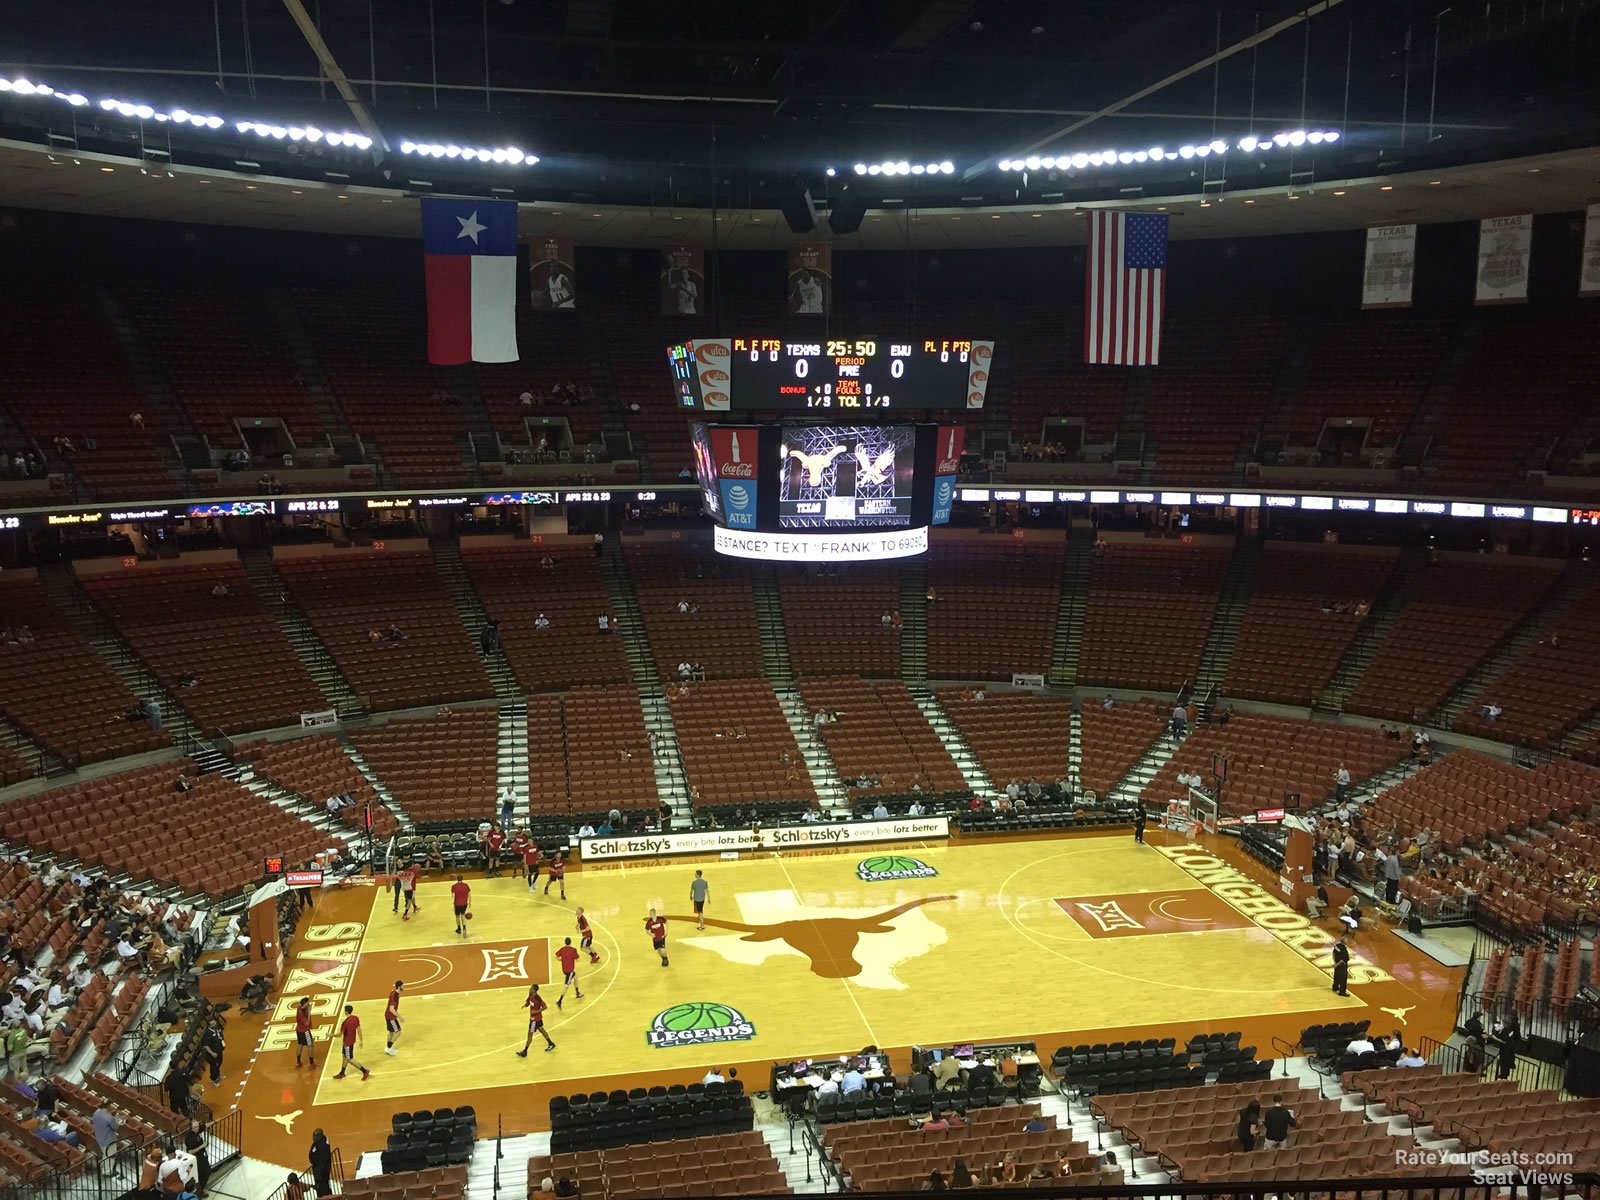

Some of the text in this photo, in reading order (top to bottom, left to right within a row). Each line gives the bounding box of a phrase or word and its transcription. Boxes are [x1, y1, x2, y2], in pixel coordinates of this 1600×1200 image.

[1492, 216, 1522, 228] TEXAS
[1377, 226, 1407, 237] TEXAS
[734, 339, 781, 352] PL F PTS
[785, 344, 821, 357] TEXAS
[826, 341, 876, 357] 25:50
[924, 341, 971, 353] PL F PTS
[750, 350, 759, 362] 0
[769, 350, 778, 362] 0
[835, 357, 865, 366] PERIOD
[940, 351, 949, 363] 0
[959, 351, 968, 363] 0
[795, 358, 809, 378] 0
[838, 365, 860, 377] PRE
[890, 359, 904, 378] 0
[780, 386, 807, 394] BONUS
[823, 383, 832, 395] 0
[837, 380, 859, 388] TEAM
[864, 383, 873, 395] 0
[835, 386, 862, 395] FOULS
[838, 396, 860, 408] TOL
[565, 493, 581, 502] APR
[287, 501, 306, 512] APR
[306, 500, 319, 511] 22
[729, 512, 753, 524] AT&T
[934, 508, 950, 520] AT&T
[532, 535, 542, 543] 21
[374, 542, 385, 550] 22
[774, 541, 809, 554] TEXT
[881, 539, 896, 552] TO
[123, 558, 136, 567] 23
[773, 822, 939, 843] Schlotzsky's every bite lotz better
[590, 837, 671, 856] Schlotzsky's
[676, 839, 699, 850] every
[700, 836, 716, 847] bite
[717, 833, 736, 845] lotz
[859, 866, 936, 880] LEGENDS
[259, 921, 366, 1052] TEXAS
[649, 1023, 754, 1044] LEGENDS
[660, 1034, 748, 1048] CLASSIC
